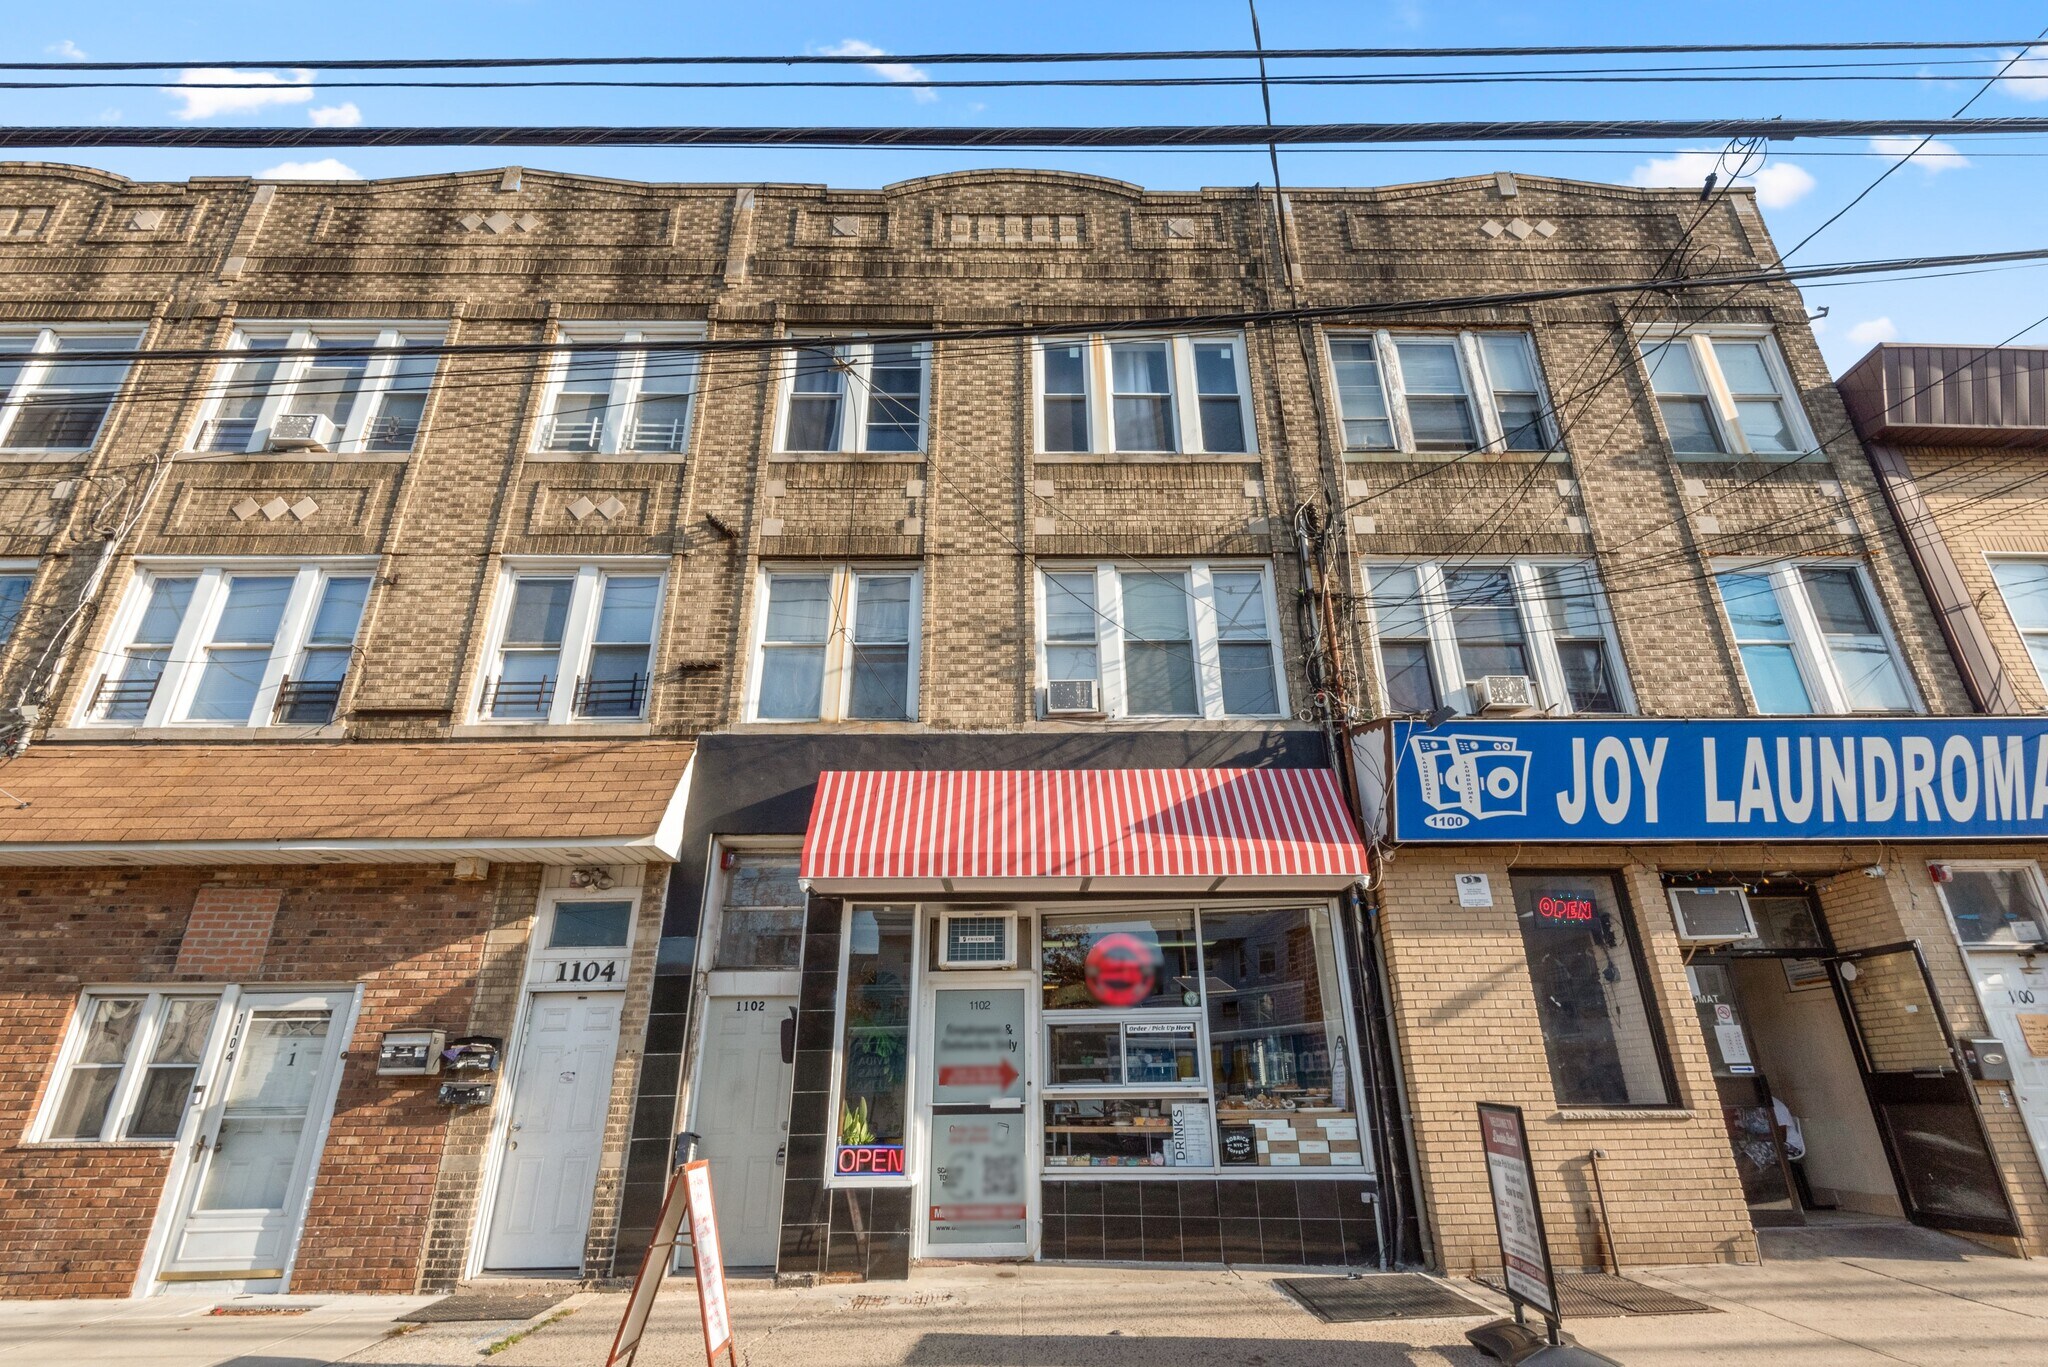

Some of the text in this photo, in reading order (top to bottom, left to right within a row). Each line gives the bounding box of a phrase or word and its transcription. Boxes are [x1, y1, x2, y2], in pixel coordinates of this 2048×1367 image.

[1556, 736, 1669, 825] JOY
[1431, 816, 1463, 827] 1100
[1539, 897, 1592, 920] OPEN
[556, 961, 616, 983] 1104
[736, 1000, 765, 1011] 1102
[969, 1000, 991, 1010] 1102
[1005, 1024, 1013, 1035] &
[1166, 1024, 1175, 1032] Up
[287, 1052, 297, 1067] 1
[1172, 1109, 1186, 1161] DRINKS
[838, 1149, 905, 1172] OPEN
